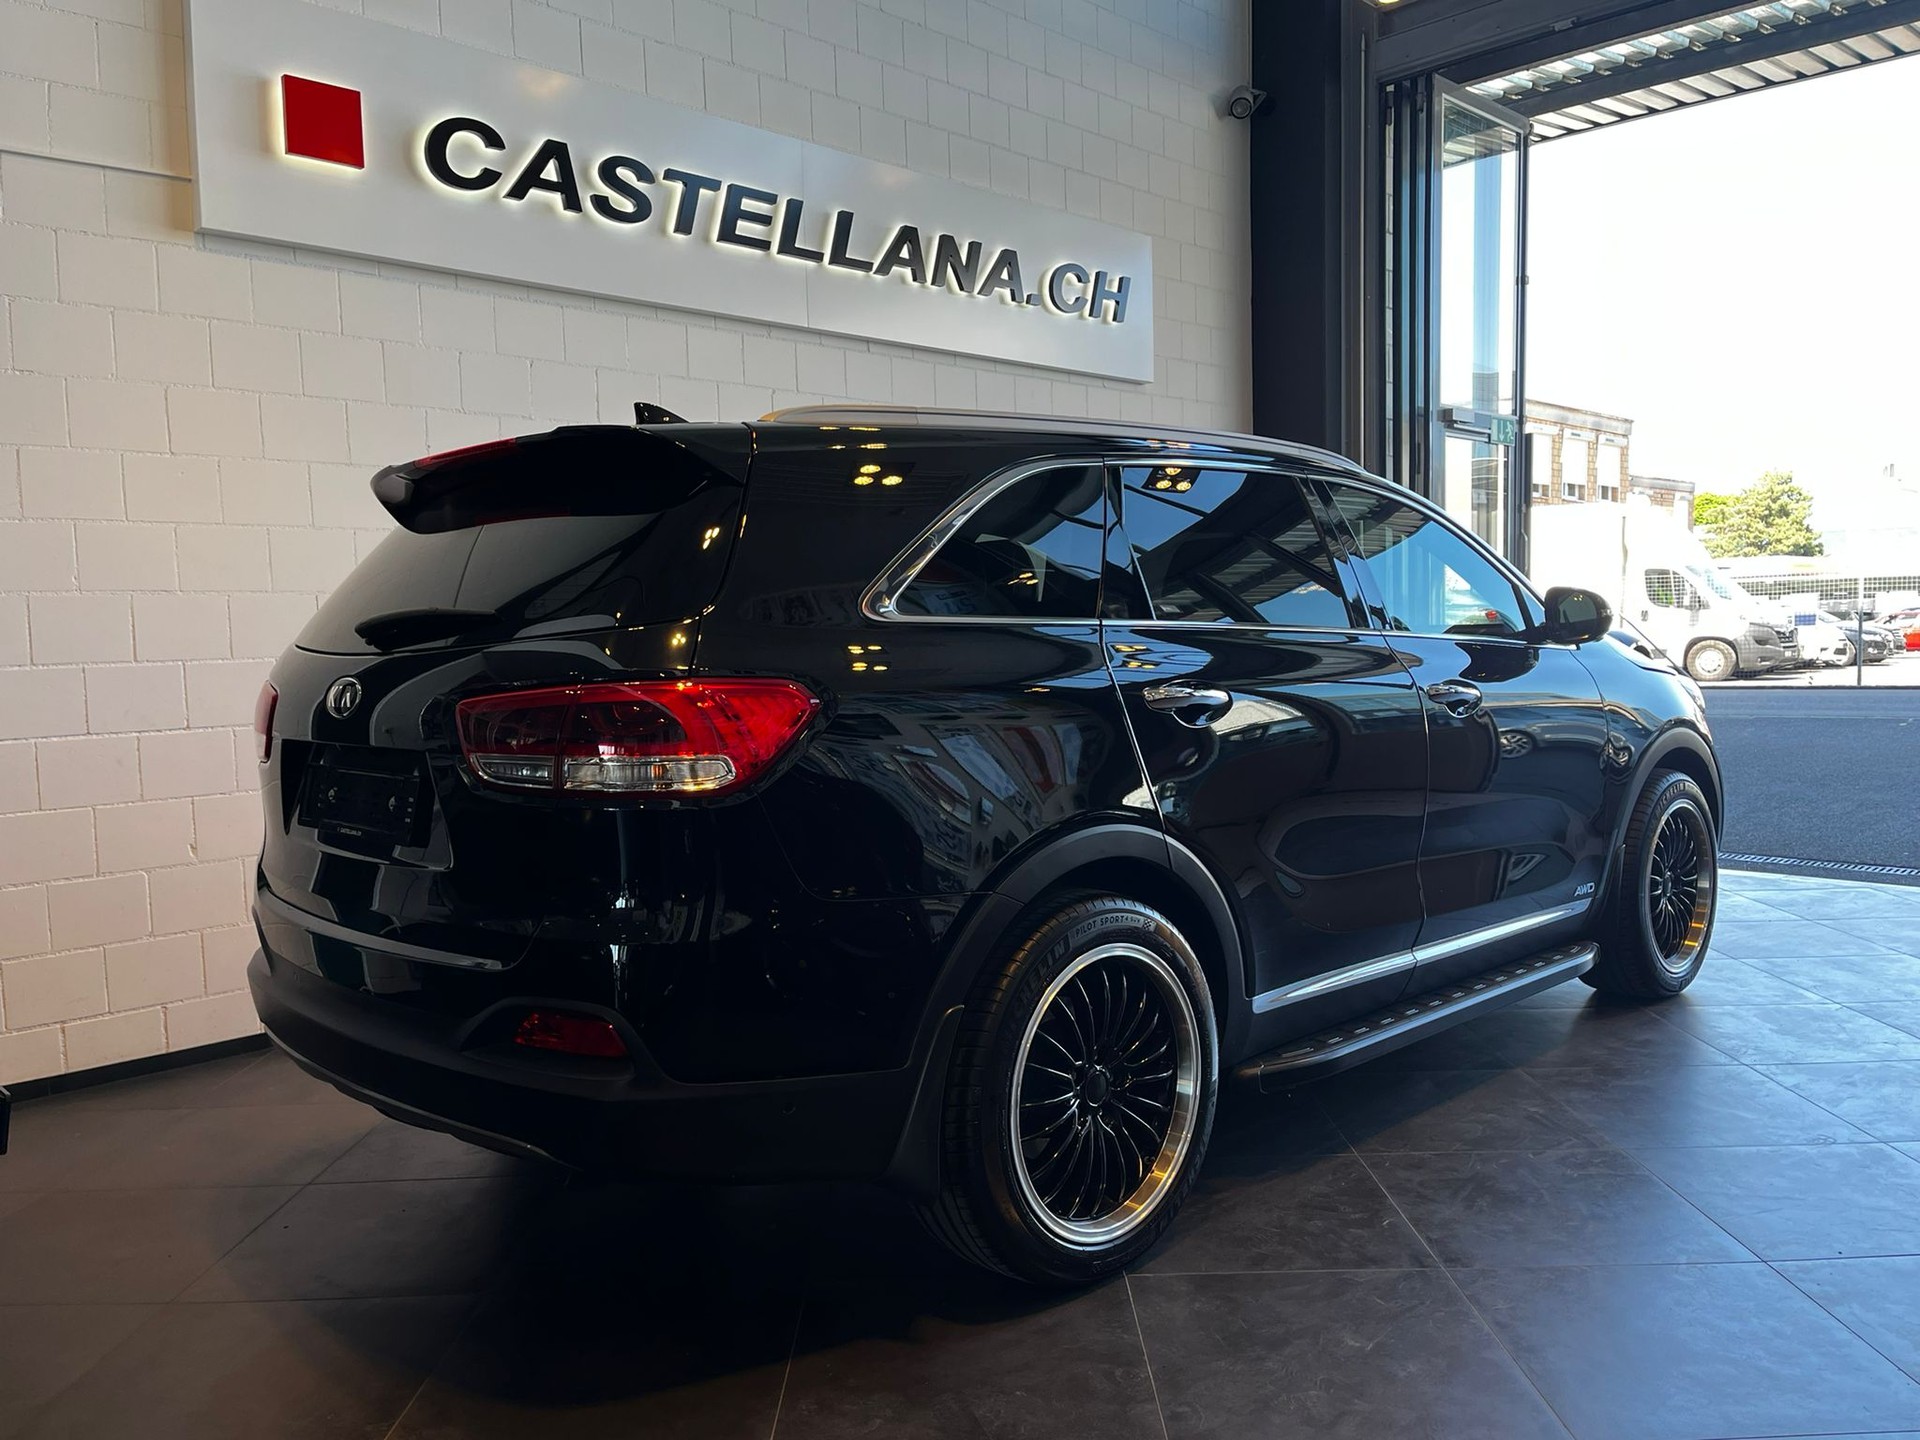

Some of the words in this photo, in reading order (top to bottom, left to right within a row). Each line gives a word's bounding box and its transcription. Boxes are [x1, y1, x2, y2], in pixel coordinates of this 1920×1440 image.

[424, 116, 1131, 323] CASTELLANA.CH
[1574, 882, 1595, 897] AWD
[1075, 921, 1097, 938] PILOT
[1100, 915, 1124, 927] SPORT
